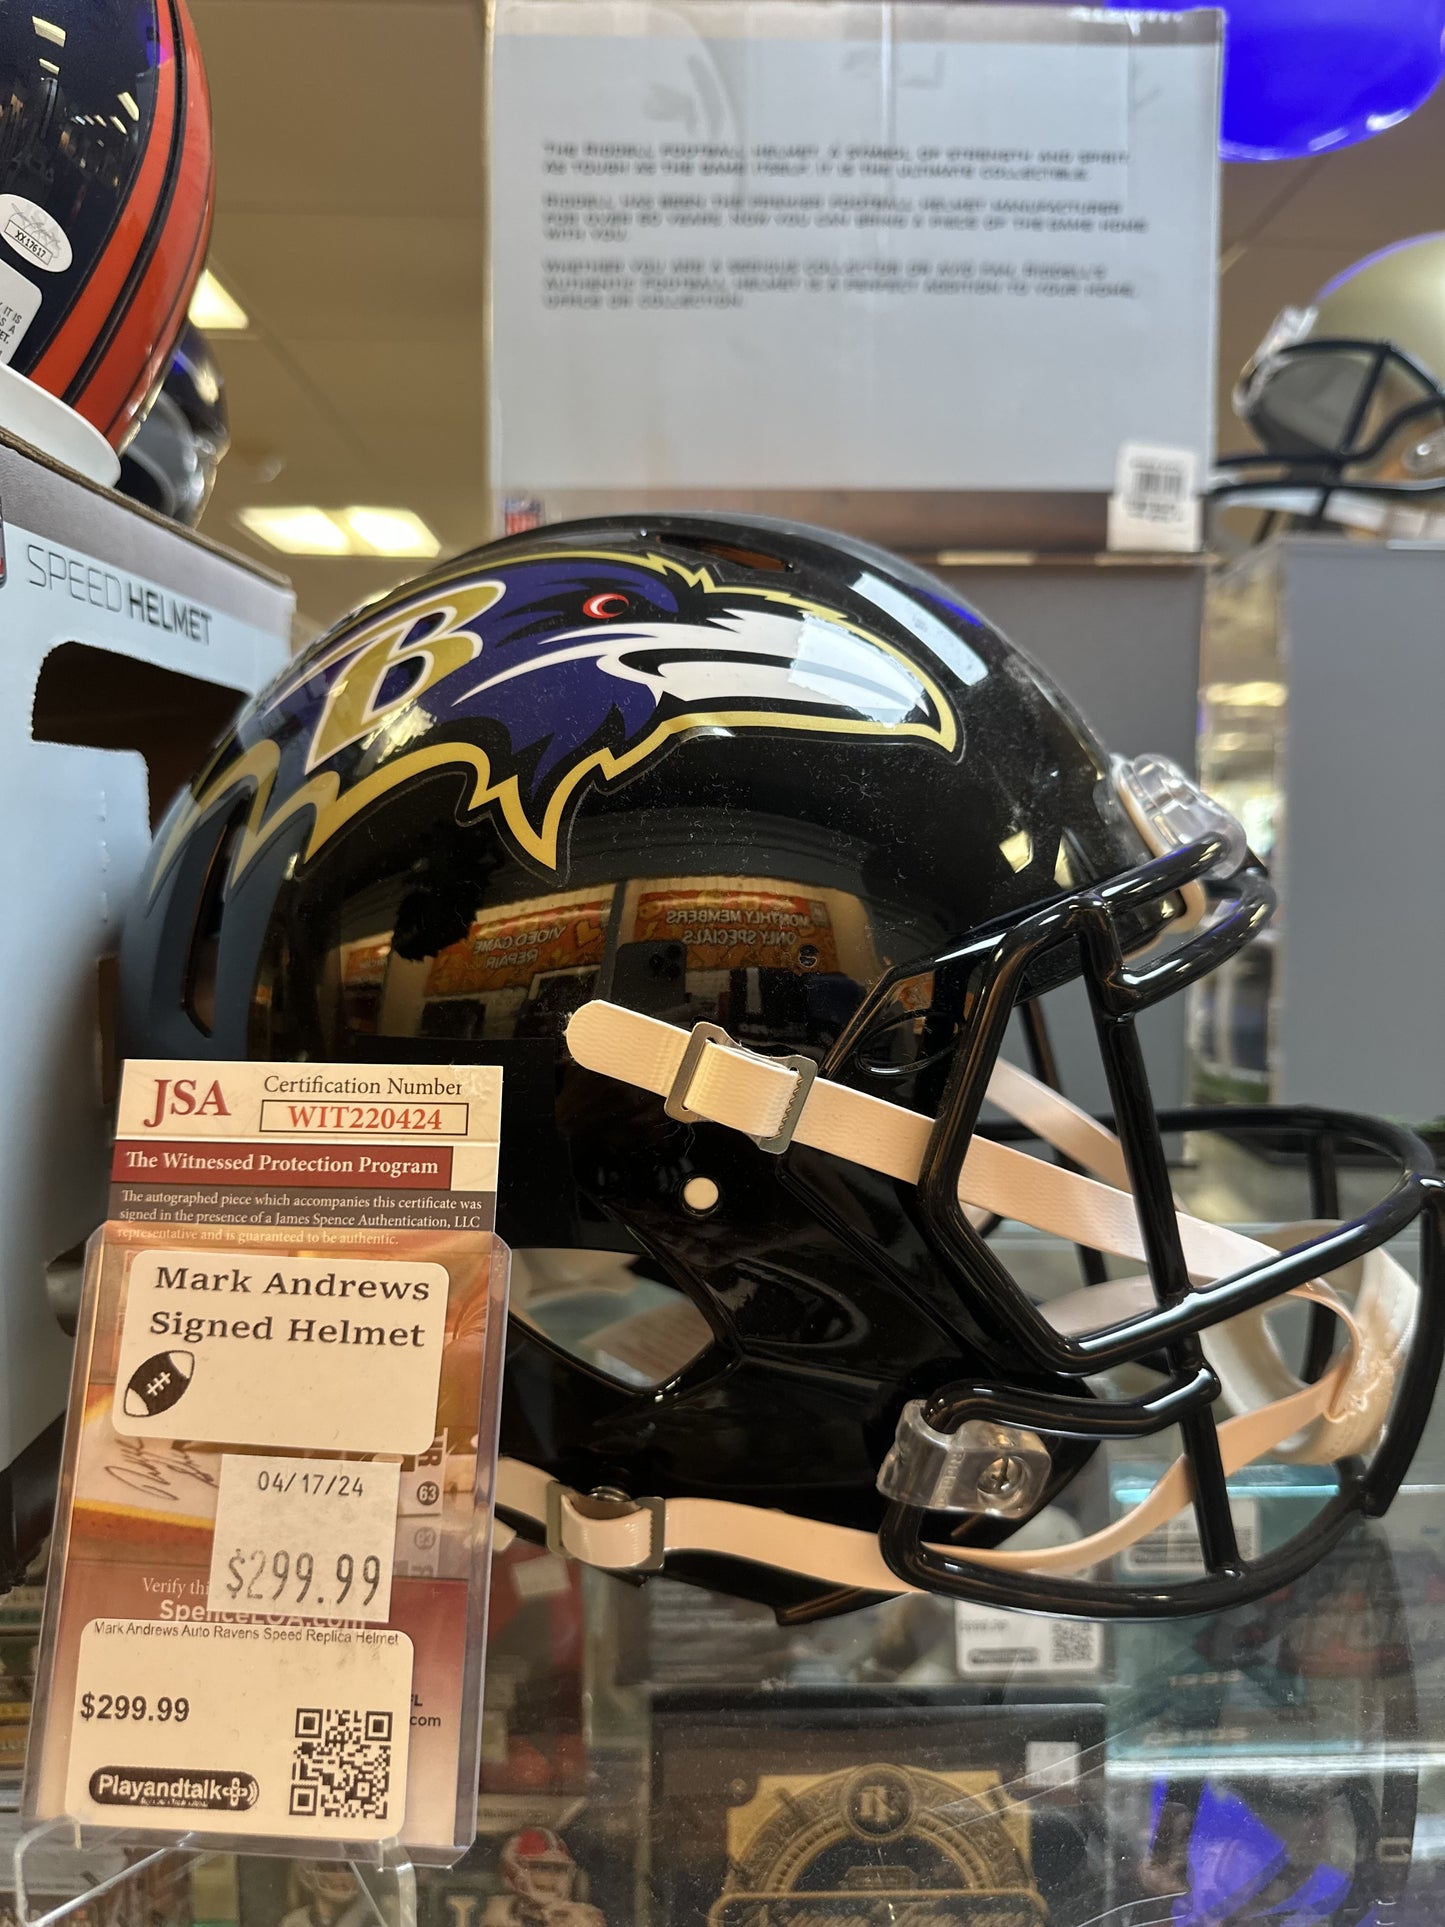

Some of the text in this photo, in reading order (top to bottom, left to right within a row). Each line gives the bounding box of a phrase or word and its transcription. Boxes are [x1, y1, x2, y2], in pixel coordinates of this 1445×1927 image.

[14, 229, 47, 258] XX17617
[12, 313, 22, 324] IS
[27, 544, 212, 645] SPEED HELMET
[264, 1075, 463, 1097] Certification Number
[144, 1078, 231, 1128] JSA
[288, 1105, 443, 1131] WIT220424
[126, 1150, 439, 1178] The Witnessed Protection Program
[122, 1190, 482, 1210] The autographed piece which accompanies this certificate was
[120, 1208, 481, 1229] signed in the presence of a James Spence Authentication, LLC
[117, 1226, 399, 1246] representative and is guaranteed to be authentic.
[154, 1266, 430, 1302] Mark Andrews
[150, 1311, 426, 1348] Signed Helmet
[257, 1470, 364, 1497] 04/17/24
[142, 1577, 187, 1598] Verify
[226, 1548, 381, 1606] $299.99
[126, 1622, 179, 1637] Andrews
[181, 1624, 210, 1638] Auto
[213, 1625, 260, 1640] Ravens
[306, 1629, 352, 1645] Replica
[356, 1631, 399, 1646] Helmet
[80, 1691, 190, 1722] $299.99
[98, 1773, 223, 1801] Playandtalk
